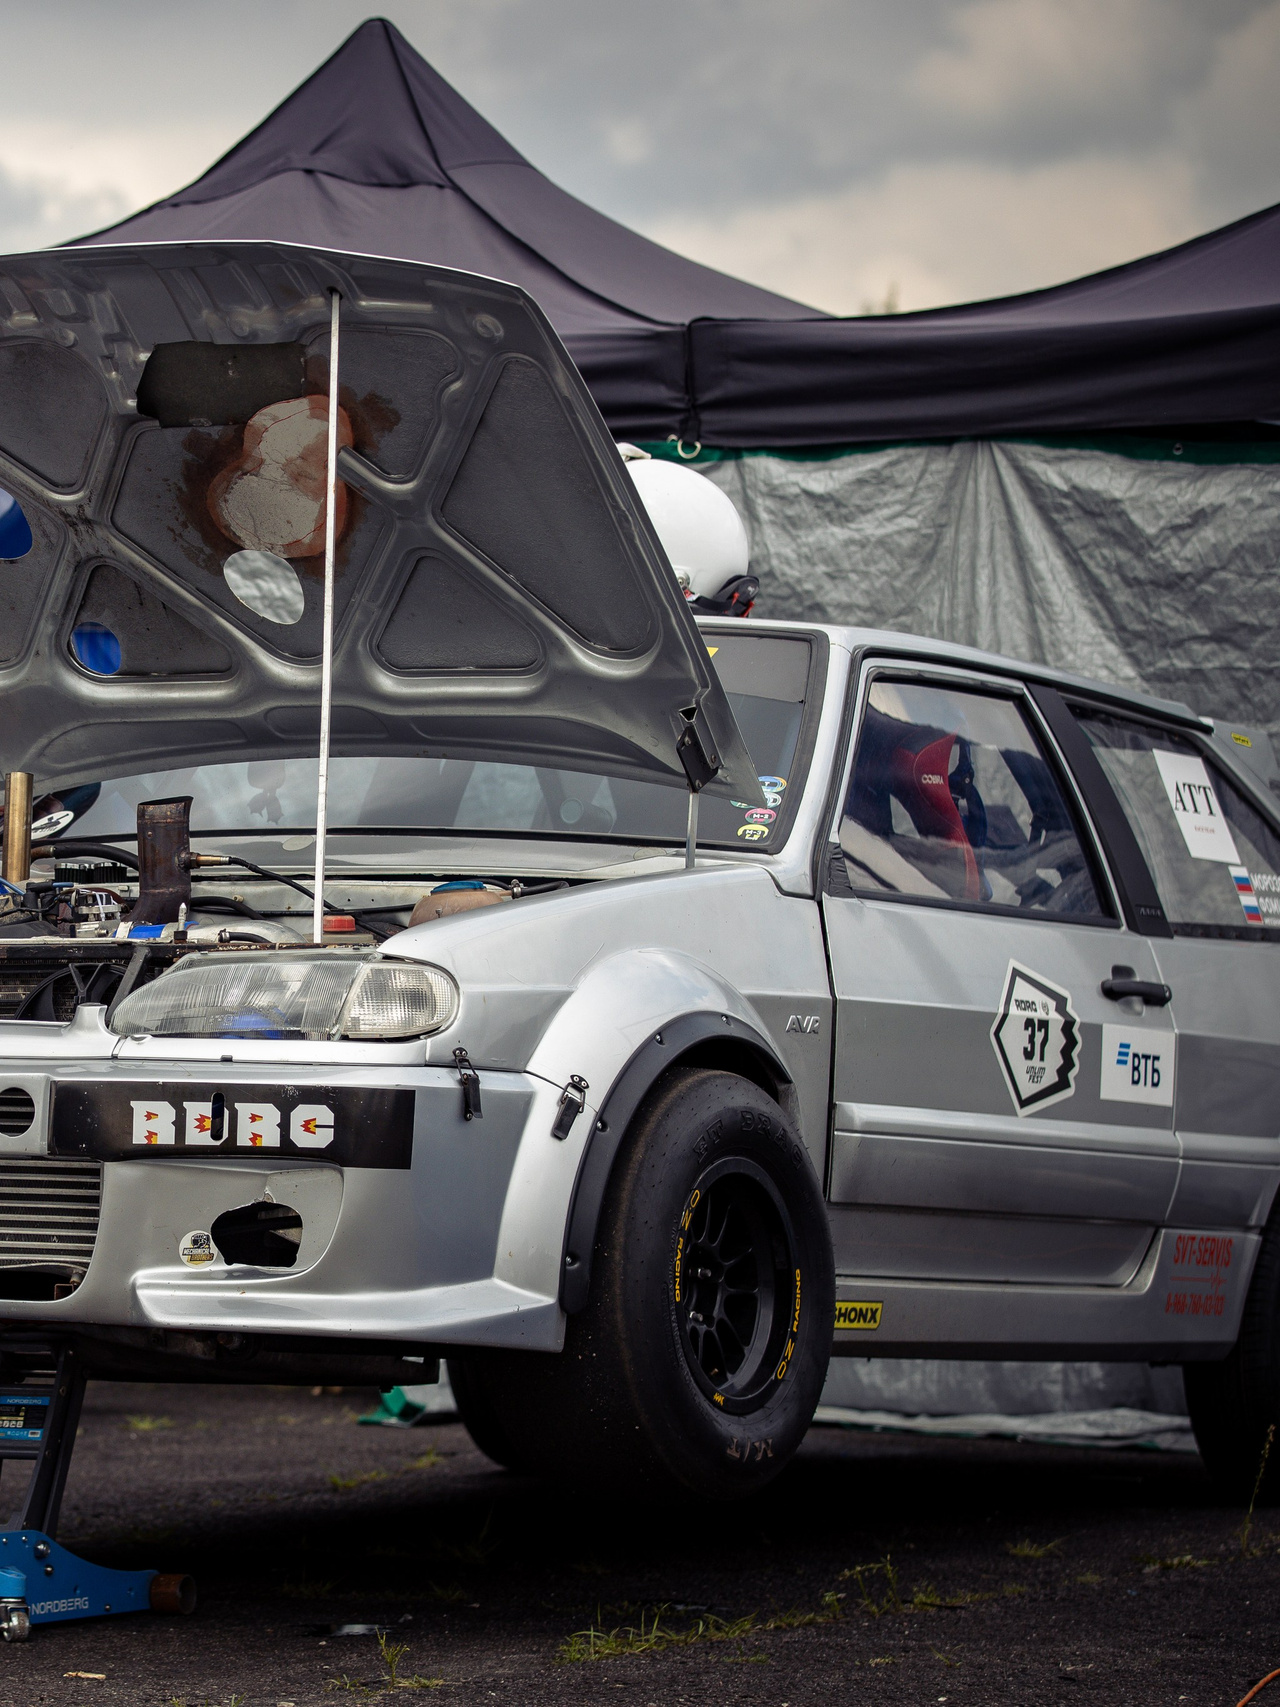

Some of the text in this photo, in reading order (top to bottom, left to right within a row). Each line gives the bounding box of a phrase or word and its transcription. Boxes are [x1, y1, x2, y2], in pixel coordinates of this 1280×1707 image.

[922, 774, 944, 784] COBRA
[1174, 781, 1217, 817] ATT
[1023, 1017, 1049, 1062] 37
[1028, 1074, 1043, 1083] FEST
[1131, 1053, 1161, 1088] ВТБ
[130, 1100, 335, 1149] RDRC
[1173, 1234, 1233, 1268] SVT-SERVIS
[674, 1236, 684, 1302] RACING
[792, 1268, 801, 1332] RACING
[835, 1306, 880, 1323] HONX
[31, 1597, 89, 1615] NORDBERG
